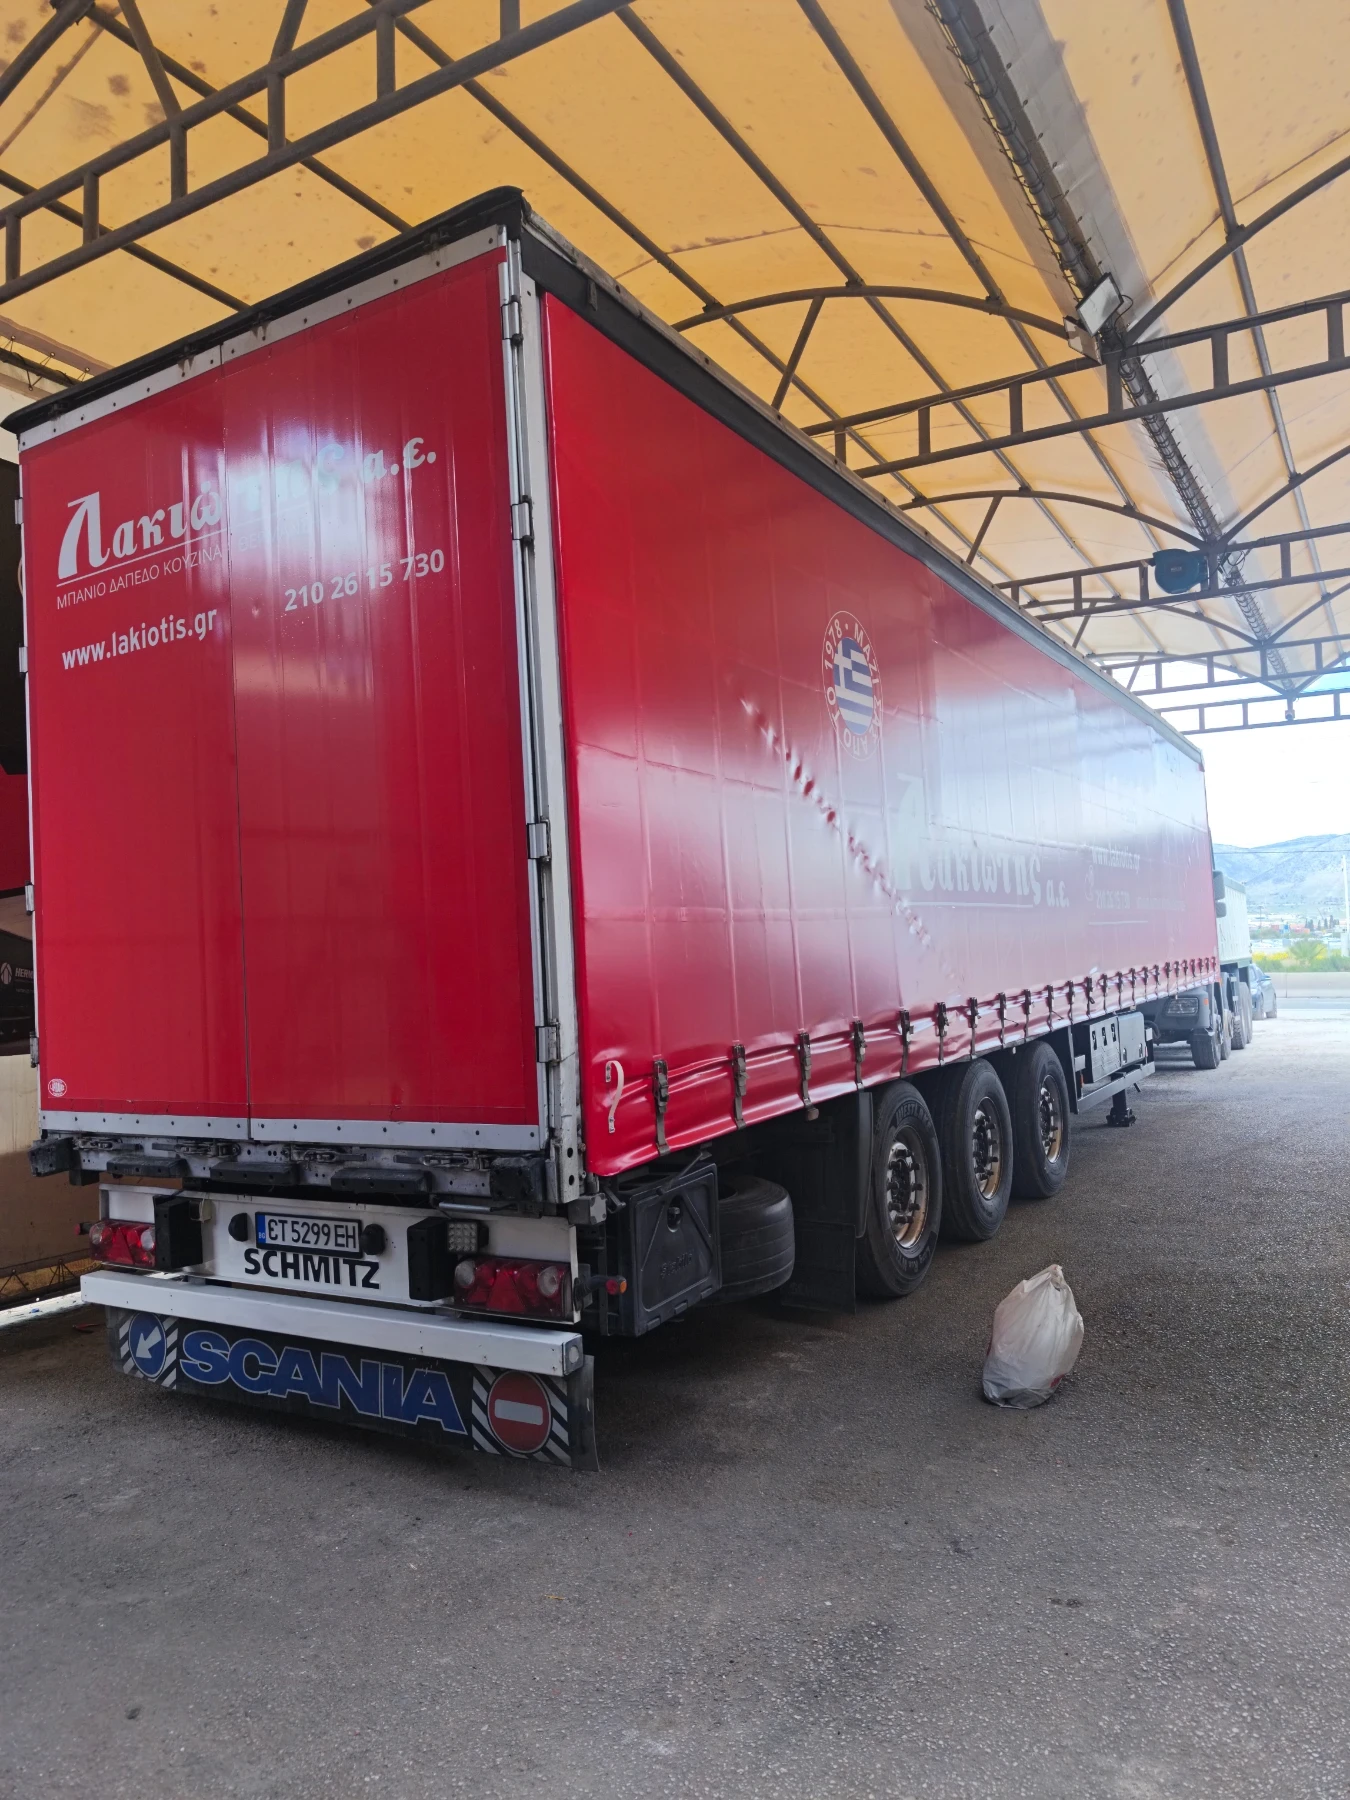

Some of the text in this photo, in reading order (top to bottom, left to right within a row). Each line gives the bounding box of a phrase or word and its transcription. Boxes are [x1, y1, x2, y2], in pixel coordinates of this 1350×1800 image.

[56, 581, 107, 610] ΜΠΑΝΙΟ
[109, 563, 160, 593] ΔΑΠΕΔΟ
[162, 545, 223, 575] ΚΟΥΖΙΝΑ
[284, 548, 445, 612] 210 26 15 730
[62, 606, 218, 670] www.lakiotis.gr
[823, 617, 843, 671] 1978
[244, 1248, 380, 1290] SCHMITZ
[180, 1329, 468, 1435] SCANIA
